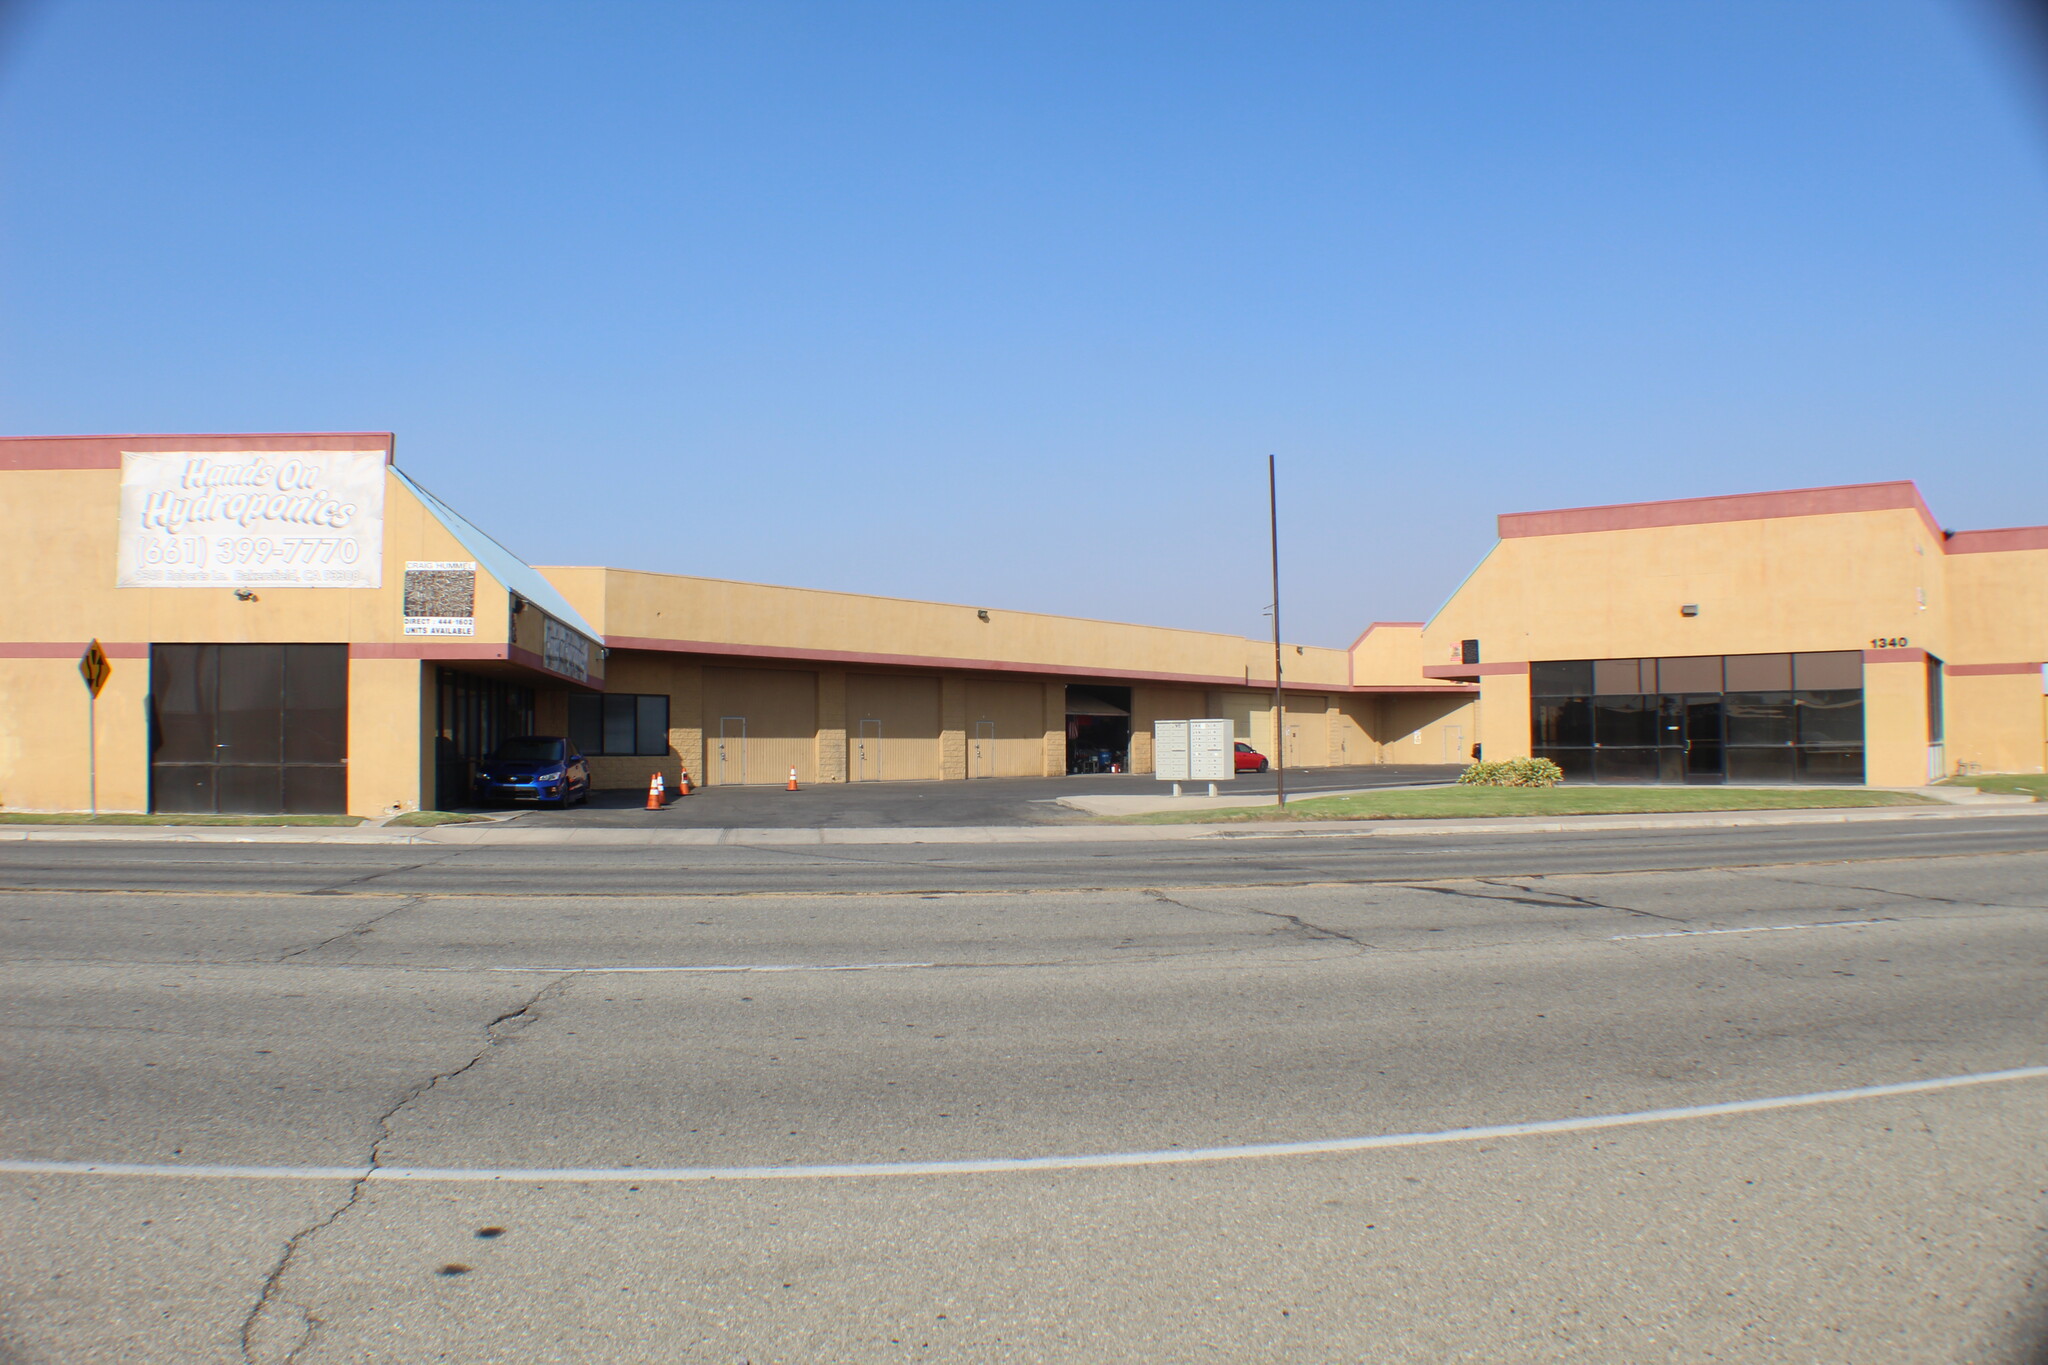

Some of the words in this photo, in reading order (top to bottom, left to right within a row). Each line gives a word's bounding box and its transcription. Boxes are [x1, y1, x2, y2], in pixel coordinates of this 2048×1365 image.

[181, 458, 273, 490] Hands
[277, 459, 320, 491] On
[141, 487, 357, 533] Hydroponics
[136, 536, 208, 568] (661)
[216, 537, 360, 565] 399-7770
[431, 627, 472, 635] AVAILABLE
[1870, 637, 1908, 648] 1340
